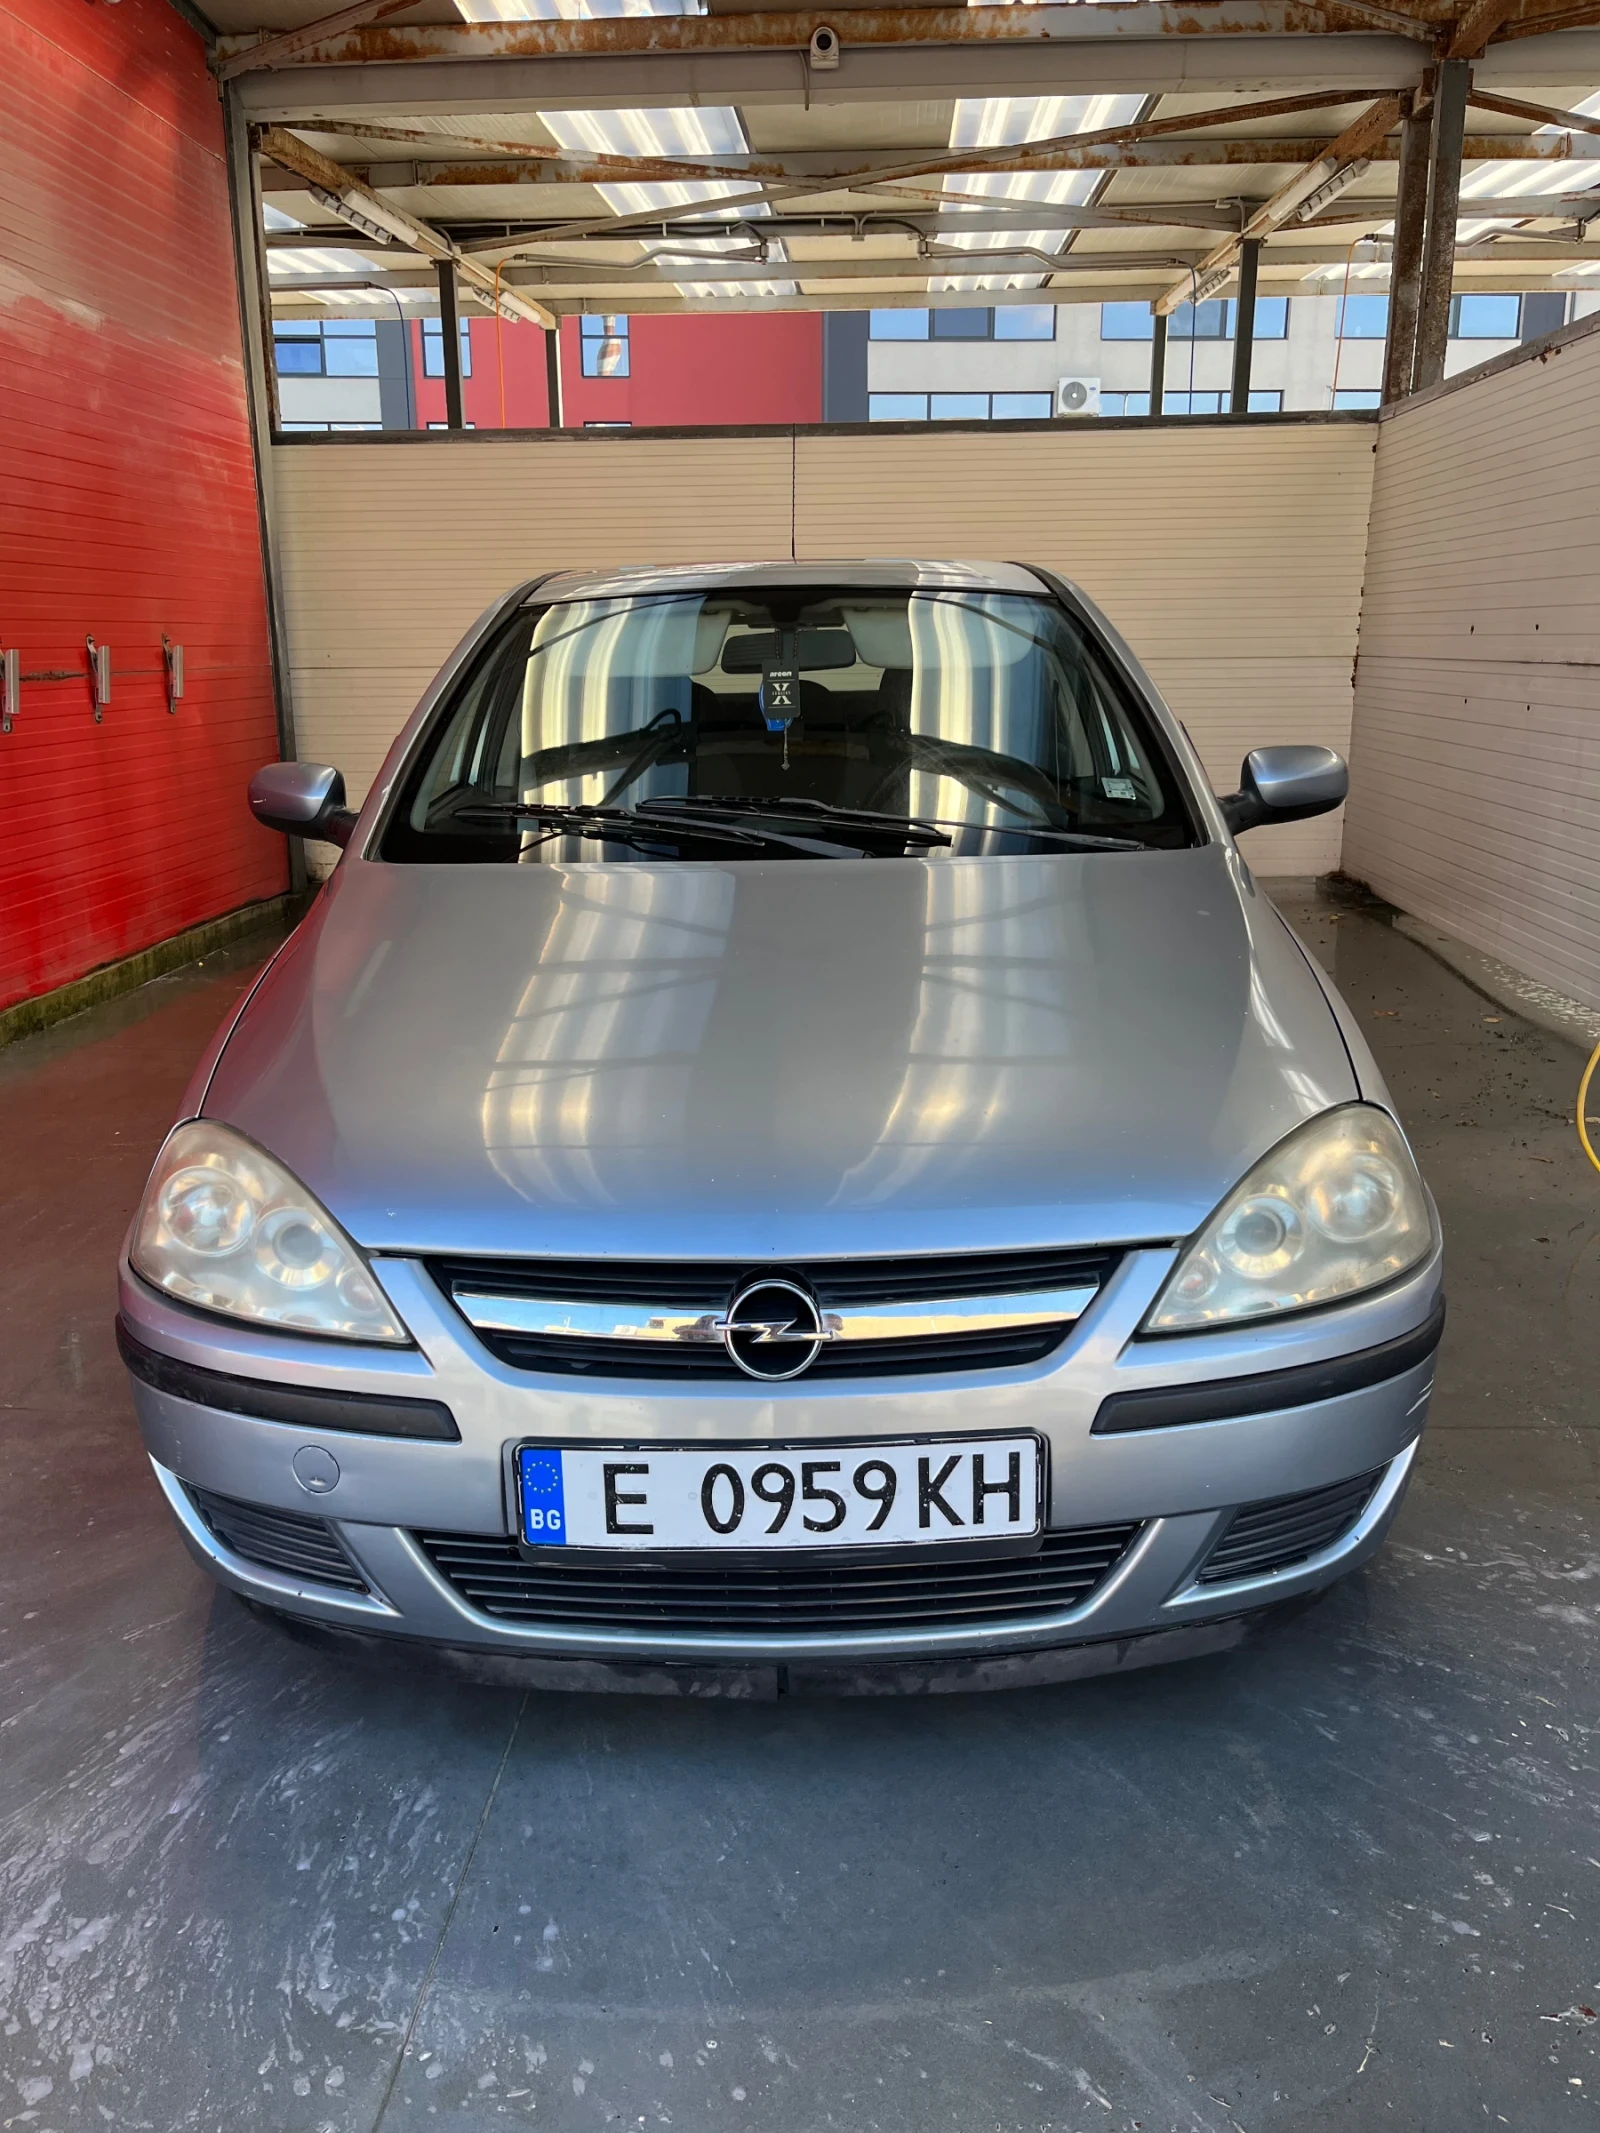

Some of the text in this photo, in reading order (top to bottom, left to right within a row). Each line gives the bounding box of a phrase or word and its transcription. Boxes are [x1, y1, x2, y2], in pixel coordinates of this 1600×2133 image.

[530, 1508, 561, 1530] BG
[602, 1451, 1021, 1535] E 0959 KH
